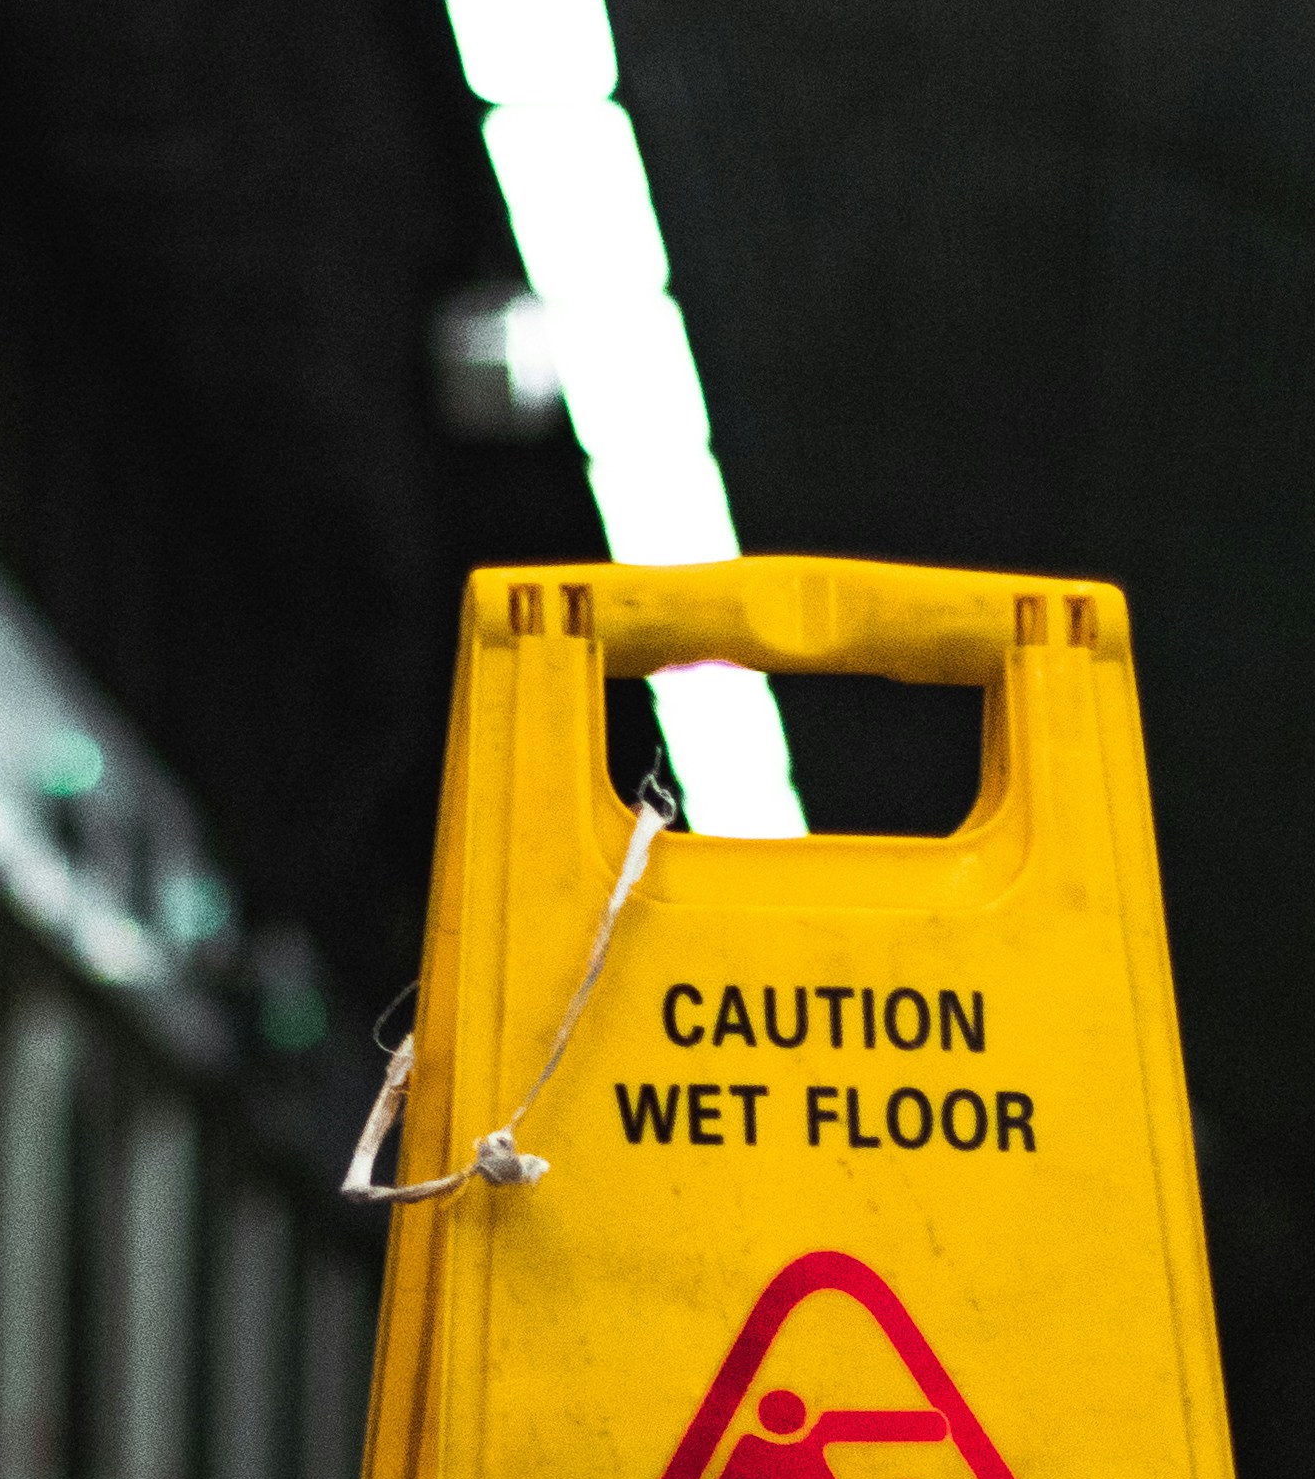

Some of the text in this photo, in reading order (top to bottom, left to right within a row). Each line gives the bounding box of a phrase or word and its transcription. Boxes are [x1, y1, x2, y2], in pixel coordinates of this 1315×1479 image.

[661, 983, 985, 1052] CAUTION
[615, 1083, 1036, 1152] WET FLOOR
